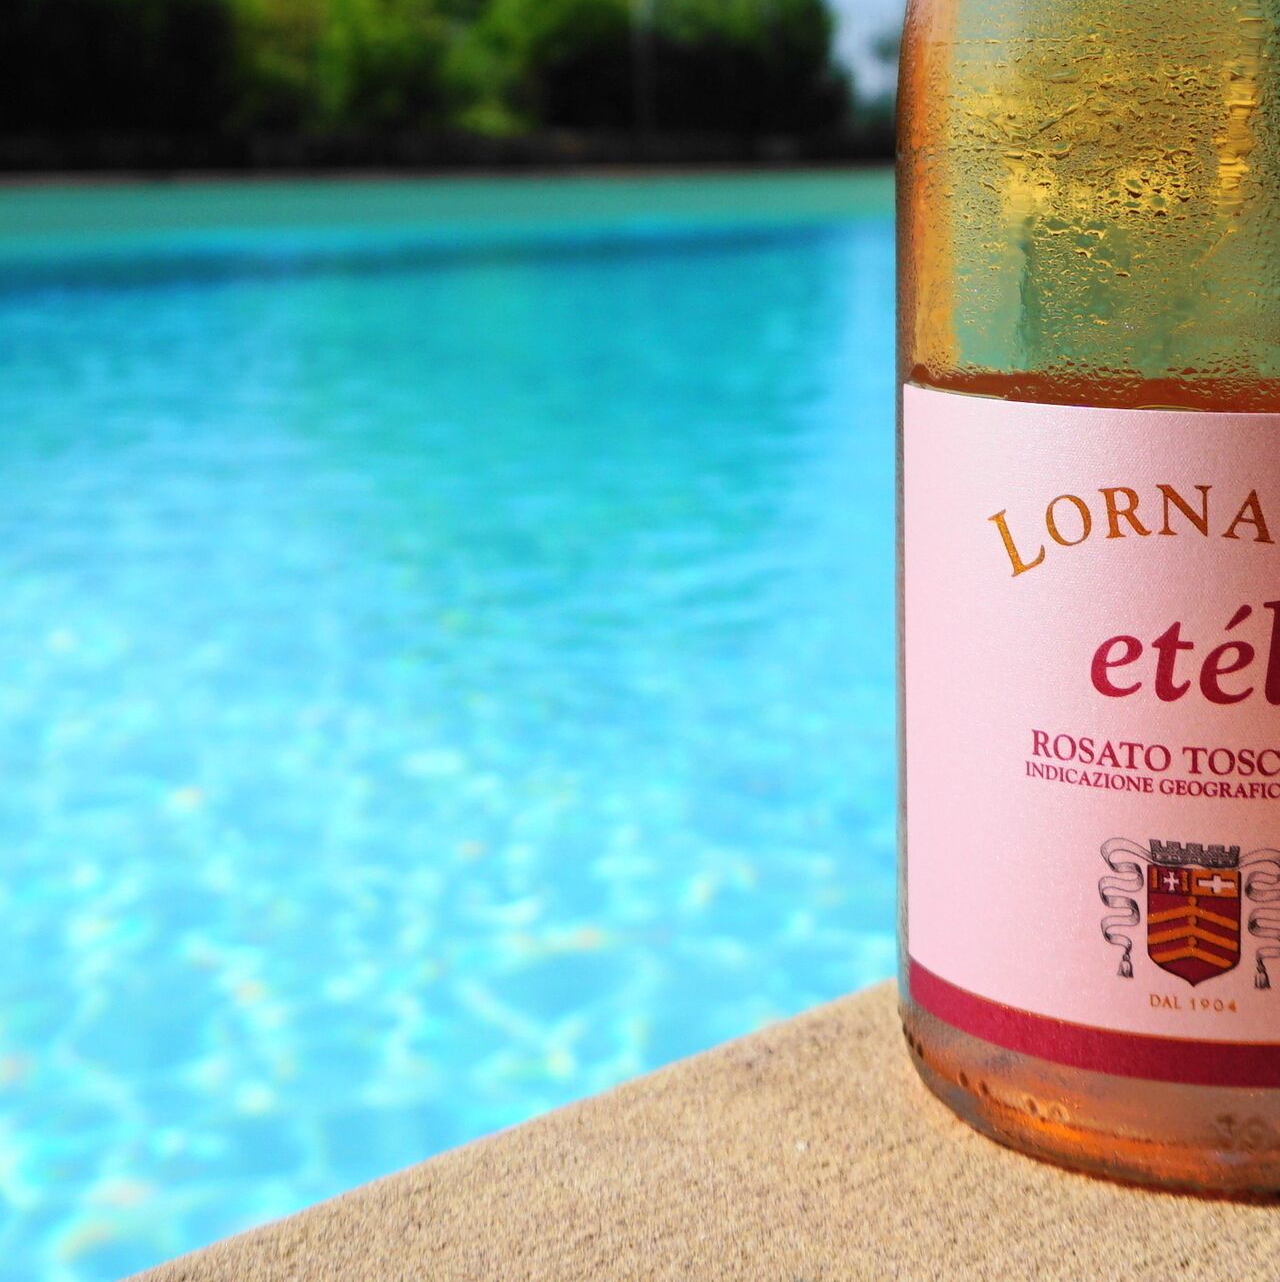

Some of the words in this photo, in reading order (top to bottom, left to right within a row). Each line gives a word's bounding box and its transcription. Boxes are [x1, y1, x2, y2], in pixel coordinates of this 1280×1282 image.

[1031, 729, 1171, 771] ROSATO
[1025, 761, 1154, 793] INDICAZIONE
[1150, 994, 1181, 1010] DAL
[1190, 998, 1238, 1013] 1904
